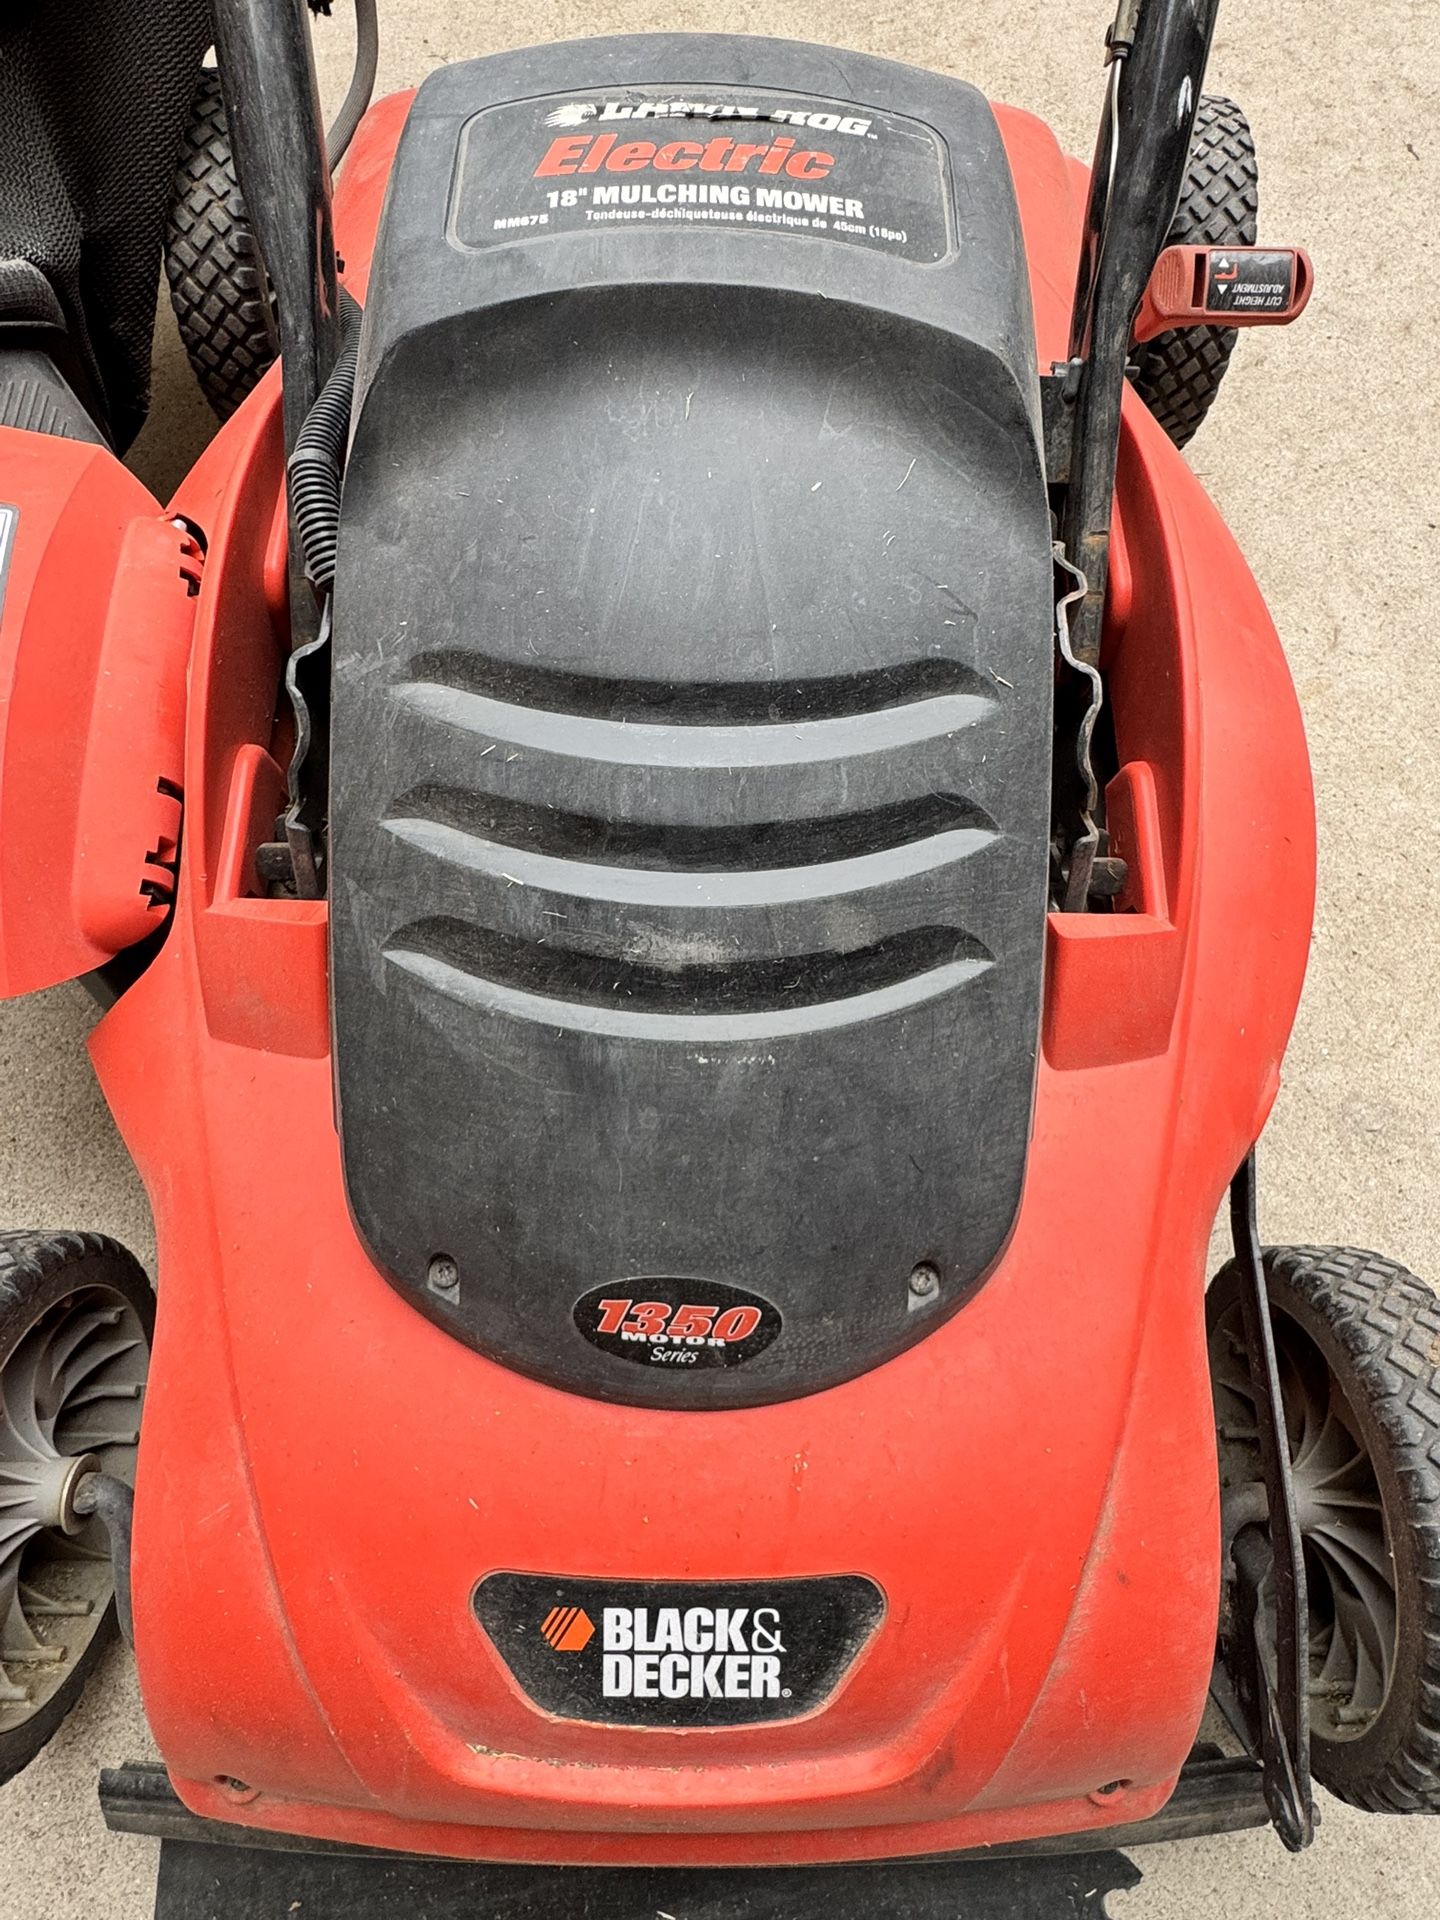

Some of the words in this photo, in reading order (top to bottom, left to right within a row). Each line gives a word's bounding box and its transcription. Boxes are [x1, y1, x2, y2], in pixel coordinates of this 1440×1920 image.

[534, 132, 836, 180] Electric
[546, 187, 588, 208] 18"
[592, 184, 750, 206] MULCHING
[755, 187, 865, 219] MOWER
[493, 213, 549, 231] MM675
[585, 207, 743, 222] Tondeuse-déchiqueteuse
[746, 212, 809, 228] électrique
[812, 219, 828, 229] de
[833, 220, 867, 236] 45cm
[869, 224, 908, 244] (18po)
[1231, 283, 1285, 294] ADJUSTMENT
[1233, 295, 1265, 306] HEIGHT
[1264, 296, 1283, 306] CUT
[597, 1298, 762, 1342] 1350
[621, 1331, 727, 1347] MOTOR
[650, 1346, 700, 1364] Series
